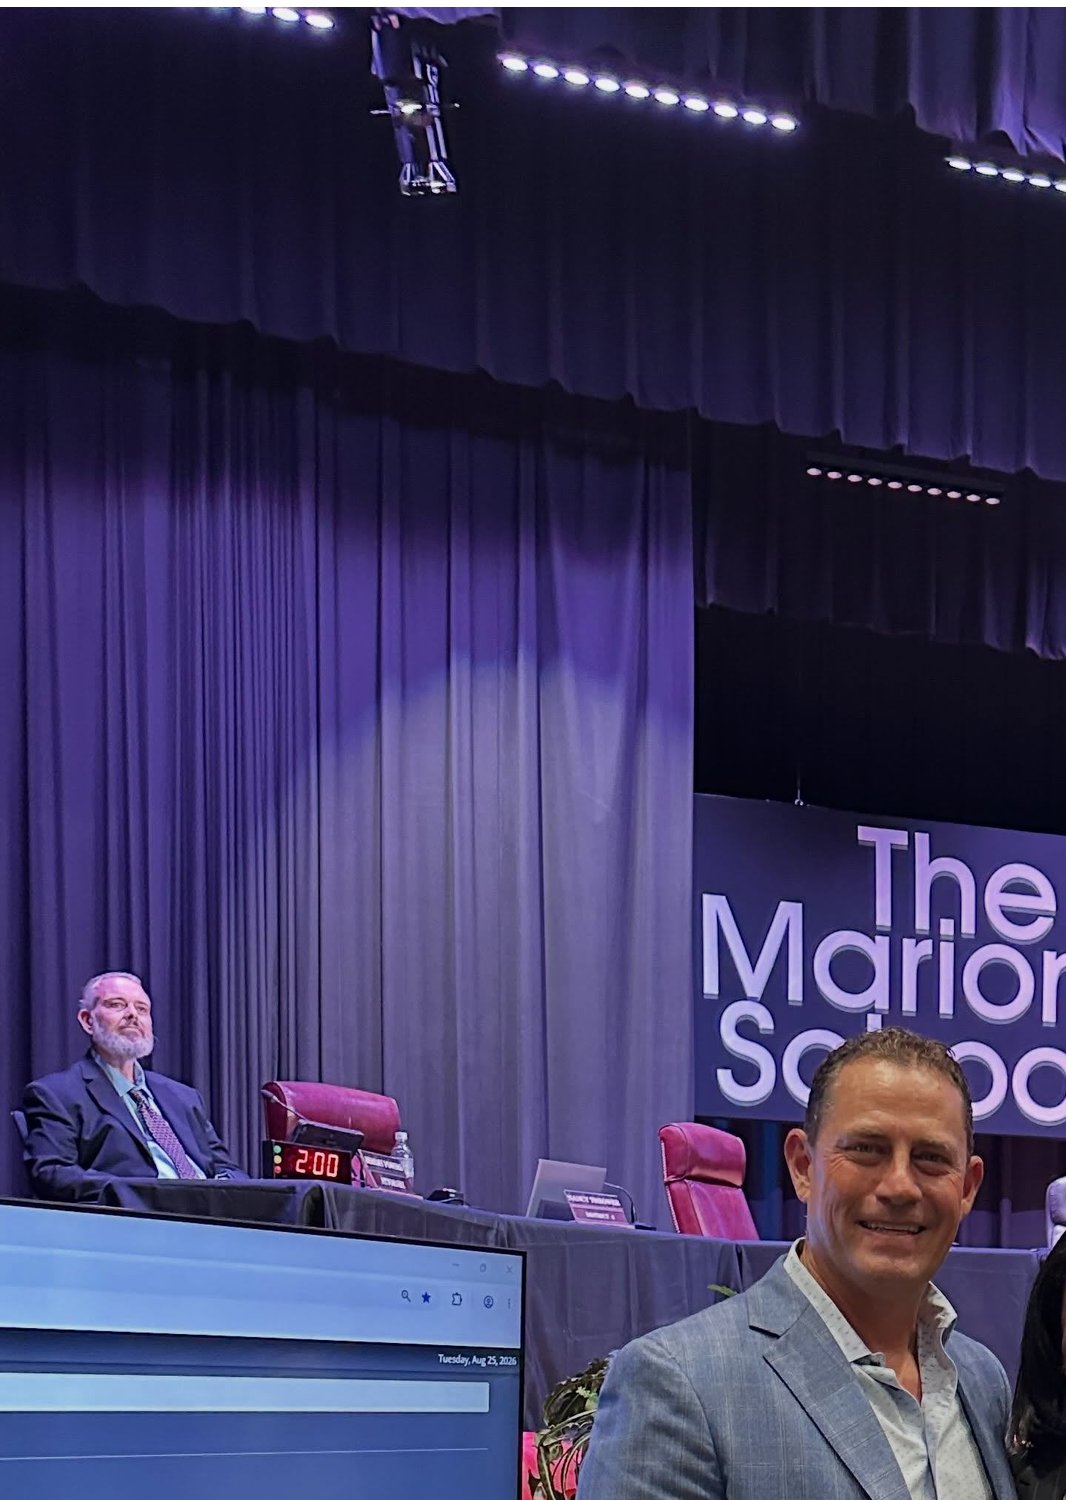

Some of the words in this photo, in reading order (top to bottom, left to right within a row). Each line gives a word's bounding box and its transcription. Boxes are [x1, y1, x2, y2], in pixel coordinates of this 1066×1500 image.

[857, 825, 1057, 945] The
[295, 1149, 340, 1178] 2:00
[438, 1353, 471, 1367] Tuesday,
[471, 1355, 486, 1367] Aug
[487, 1355, 498, 1366] 25,
[499, 1356, 517, 1366] 2026
